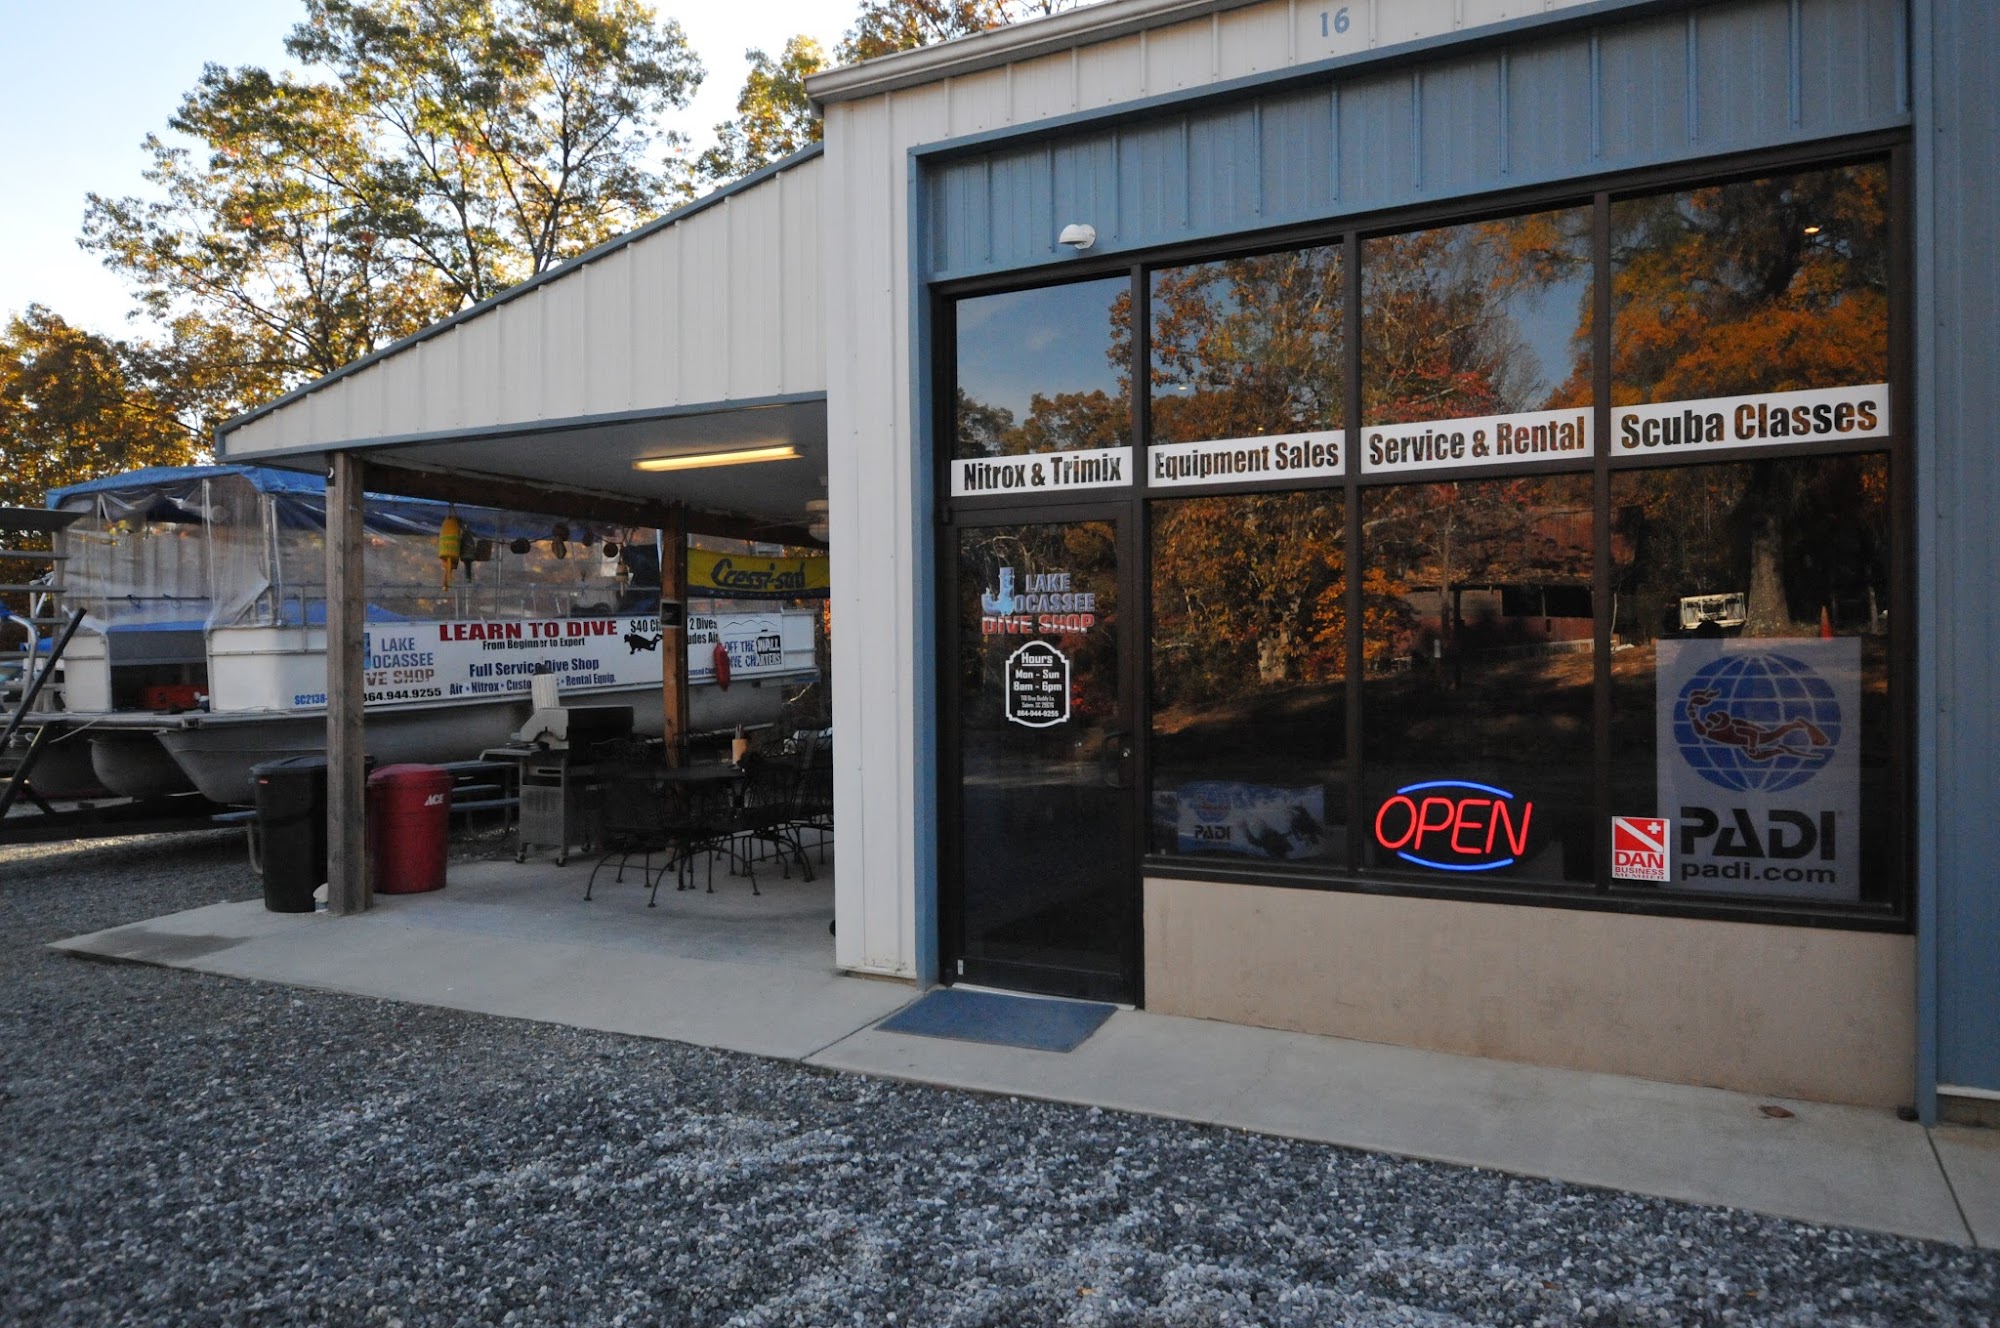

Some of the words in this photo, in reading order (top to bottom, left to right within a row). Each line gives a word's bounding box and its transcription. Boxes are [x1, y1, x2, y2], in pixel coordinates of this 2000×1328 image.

[1320, 7, 1350, 37] 16
[1621, 409, 1725, 449] Scuba
[1733, 399, 1878, 442] Classes
[1368, 429, 1466, 466] Service
[1472, 429, 1490, 458] &
[1496, 415, 1585, 456] Rental
[1154, 445, 1270, 481] Equipment
[1275, 440, 1339, 471] Sales
[963, 462, 1026, 491] Nitrox
[1031, 462, 1046, 487] &
[1051, 453, 1122, 485] Trimix
[1025, 572, 1071, 593] LAKE
[439, 622, 522, 642] LEARN
[528, 621, 559, 639] TO
[566, 620, 618, 637] DIVE
[630, 619, 648, 633] $40
[689, 618, 695, 630] 2
[696, 617, 718, 630] Dives
[981, 615, 1033, 635] DIVE
[1038, 613, 1095, 634] SHOP
[381, 637, 415, 652] LAKE
[483, 640, 506, 650] From
[507, 639, 547, 650] Beginner
[549, 639, 558, 647] to
[560, 637, 585, 647] Expert
[740, 640, 755, 652] THE
[1021, 652, 1053, 664] Hours
[393, 668, 435, 684] SHOP
[469, 663, 493, 678] Full
[495, 661, 542, 676] Service
[544, 660, 569, 673] Dive
[571, 658, 600, 671] Shop
[1015, 669, 1034, 679] Mon
[1042, 669, 1060, 679] Sun
[449, 683, 463, 695] Air
[471, 681, 499, 693] Nitrox
[506, 680, 532, 691] Custo
[566, 674, 592, 687] Rental
[1013, 681, 1034, 691] 8am
[1042, 681, 1062, 693] 6pm
[424, 793, 445, 806] ACE
[1194, 824, 1231, 840] PADI
[1375, 795, 1534, 856] OPEN
[1680, 806, 1836, 861] PADI
[1614, 851, 1664, 869] DAN
[1614, 866, 1665, 876] BUSINESS
[1680, 861, 1837, 884] padi.com
